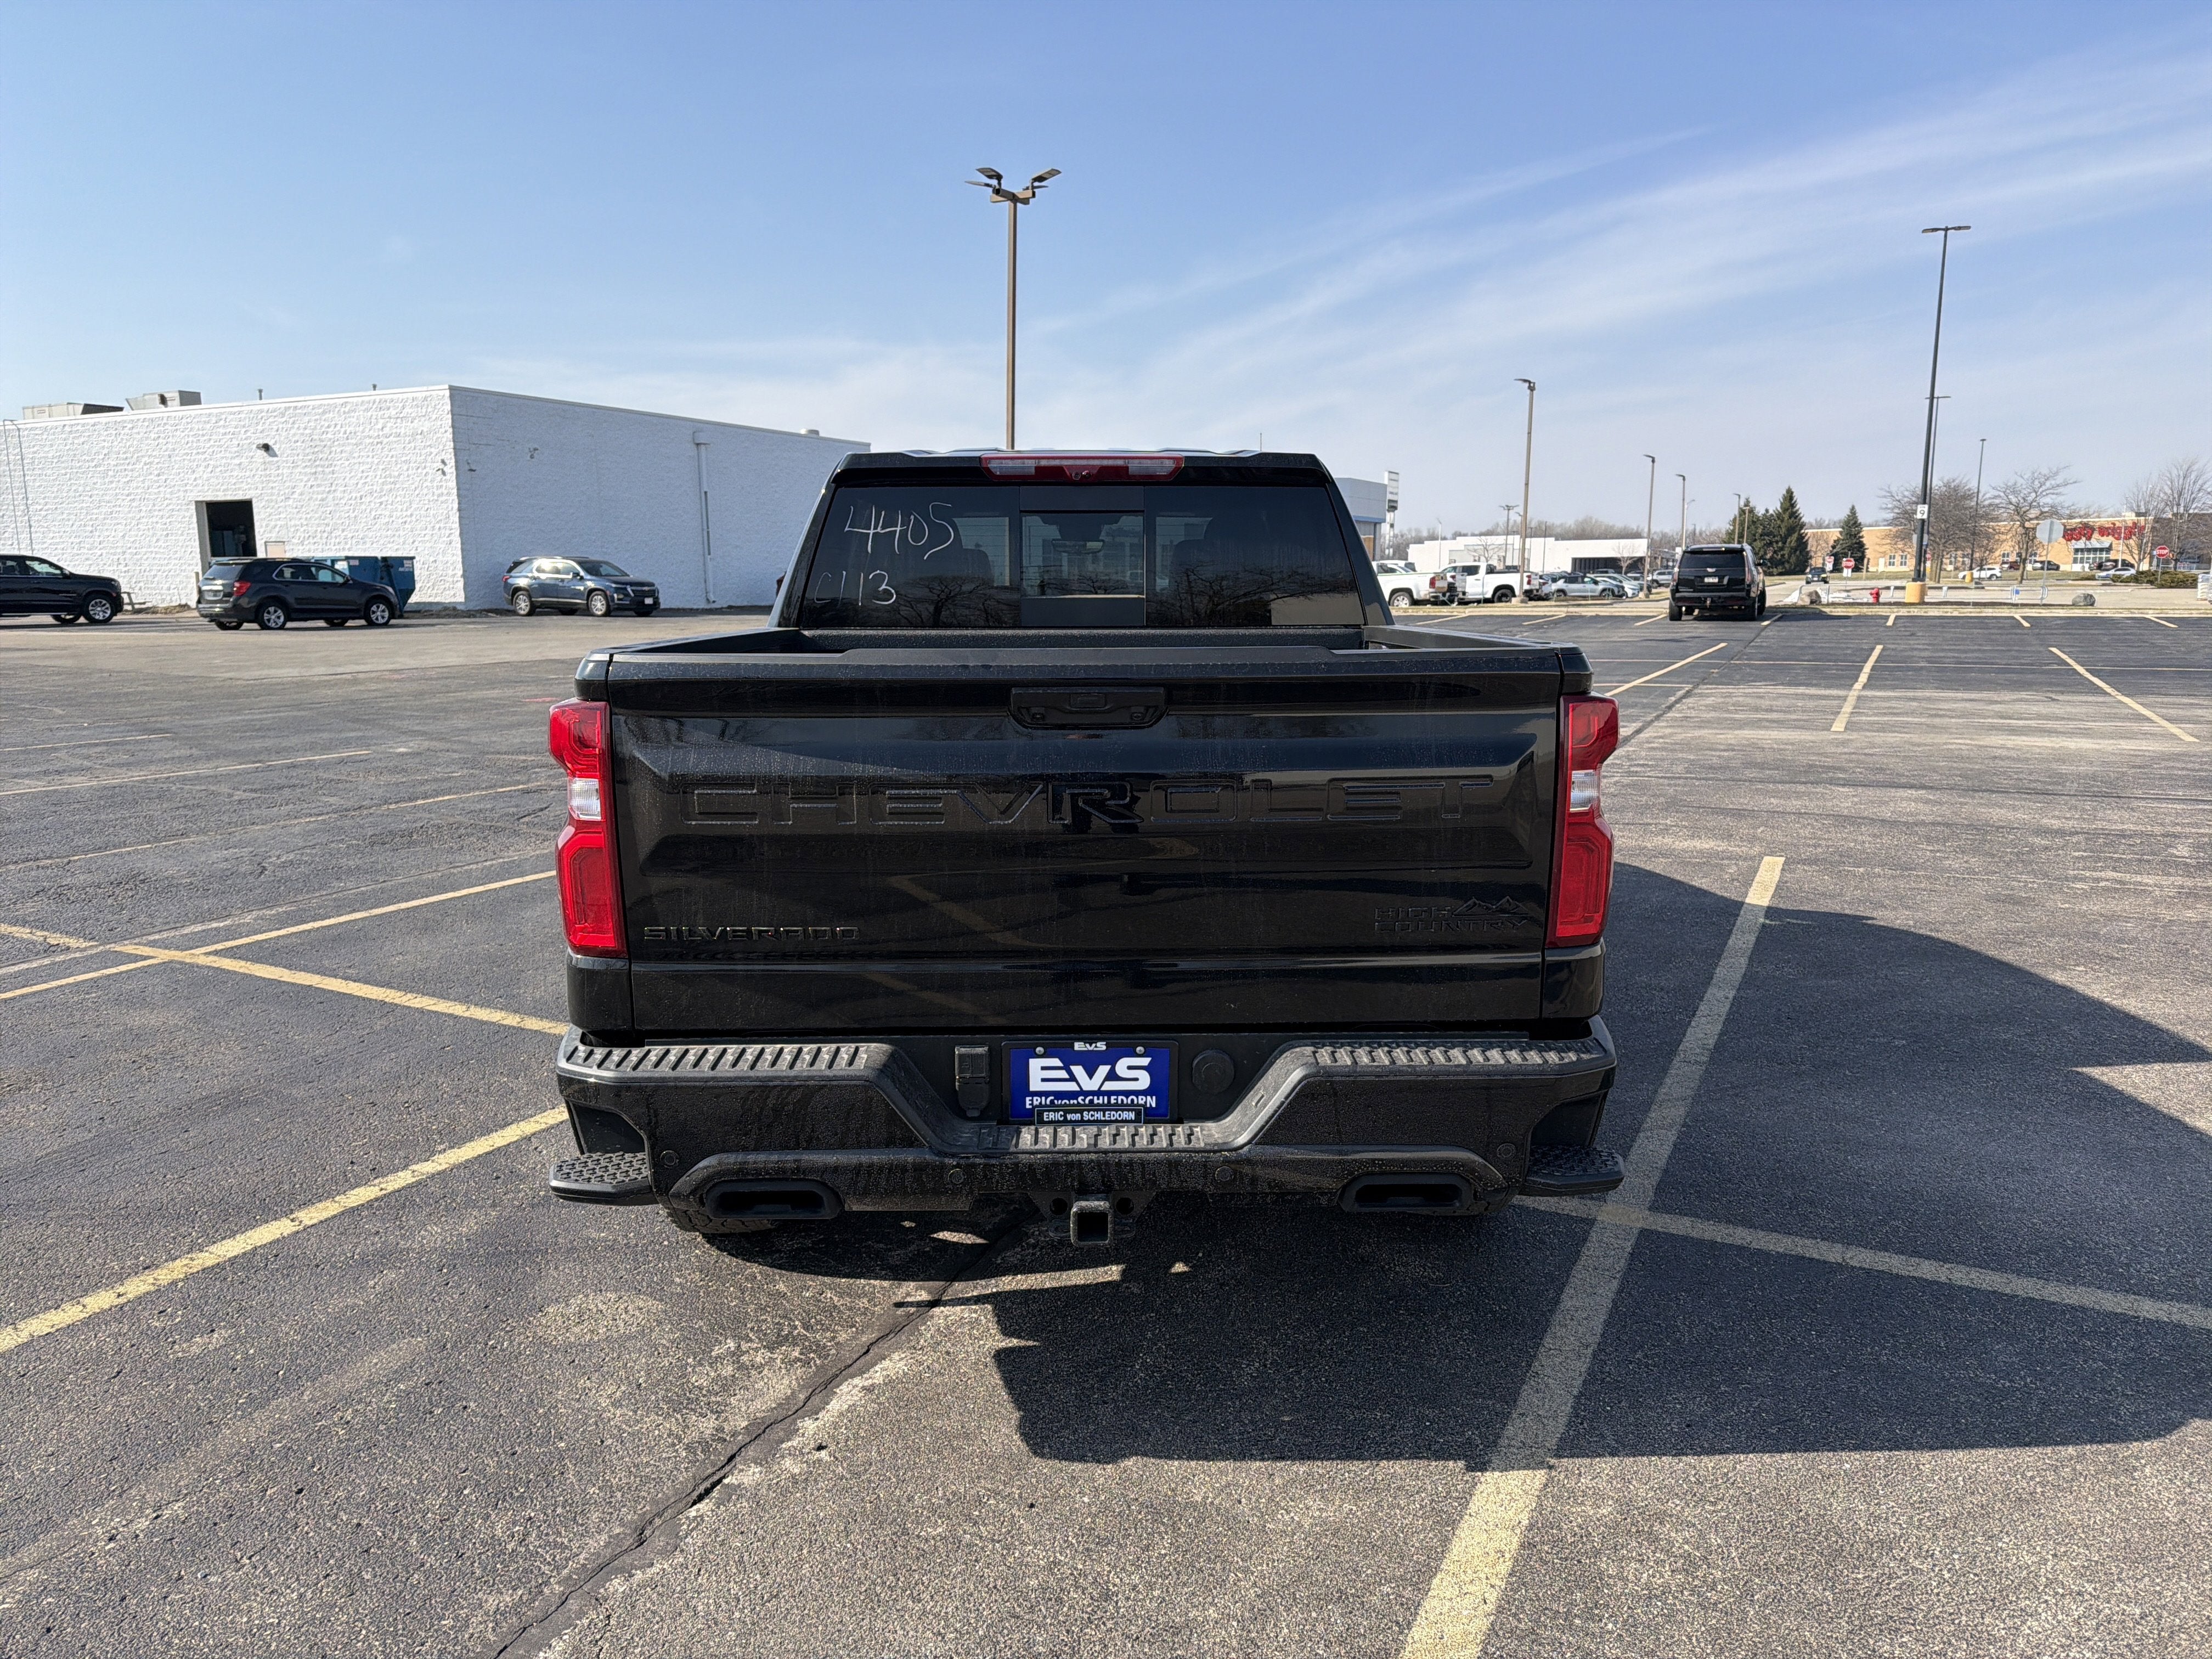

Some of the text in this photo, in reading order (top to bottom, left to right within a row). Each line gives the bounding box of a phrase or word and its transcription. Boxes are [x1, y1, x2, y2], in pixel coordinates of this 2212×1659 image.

[1919, 509, 1926, 517] 9
[844, 501, 953, 560] 4405
[681, 775, 1493, 826] CHEVROLET
[1374, 907, 1453, 920] HIGH
[1374, 919, 1529, 932] COUNTRY
[644, 926, 860, 941] SILVERADO
[1043, 1111, 1064, 1121] ERIC
[1083, 1111, 1135, 1121] SCHLEDORN
